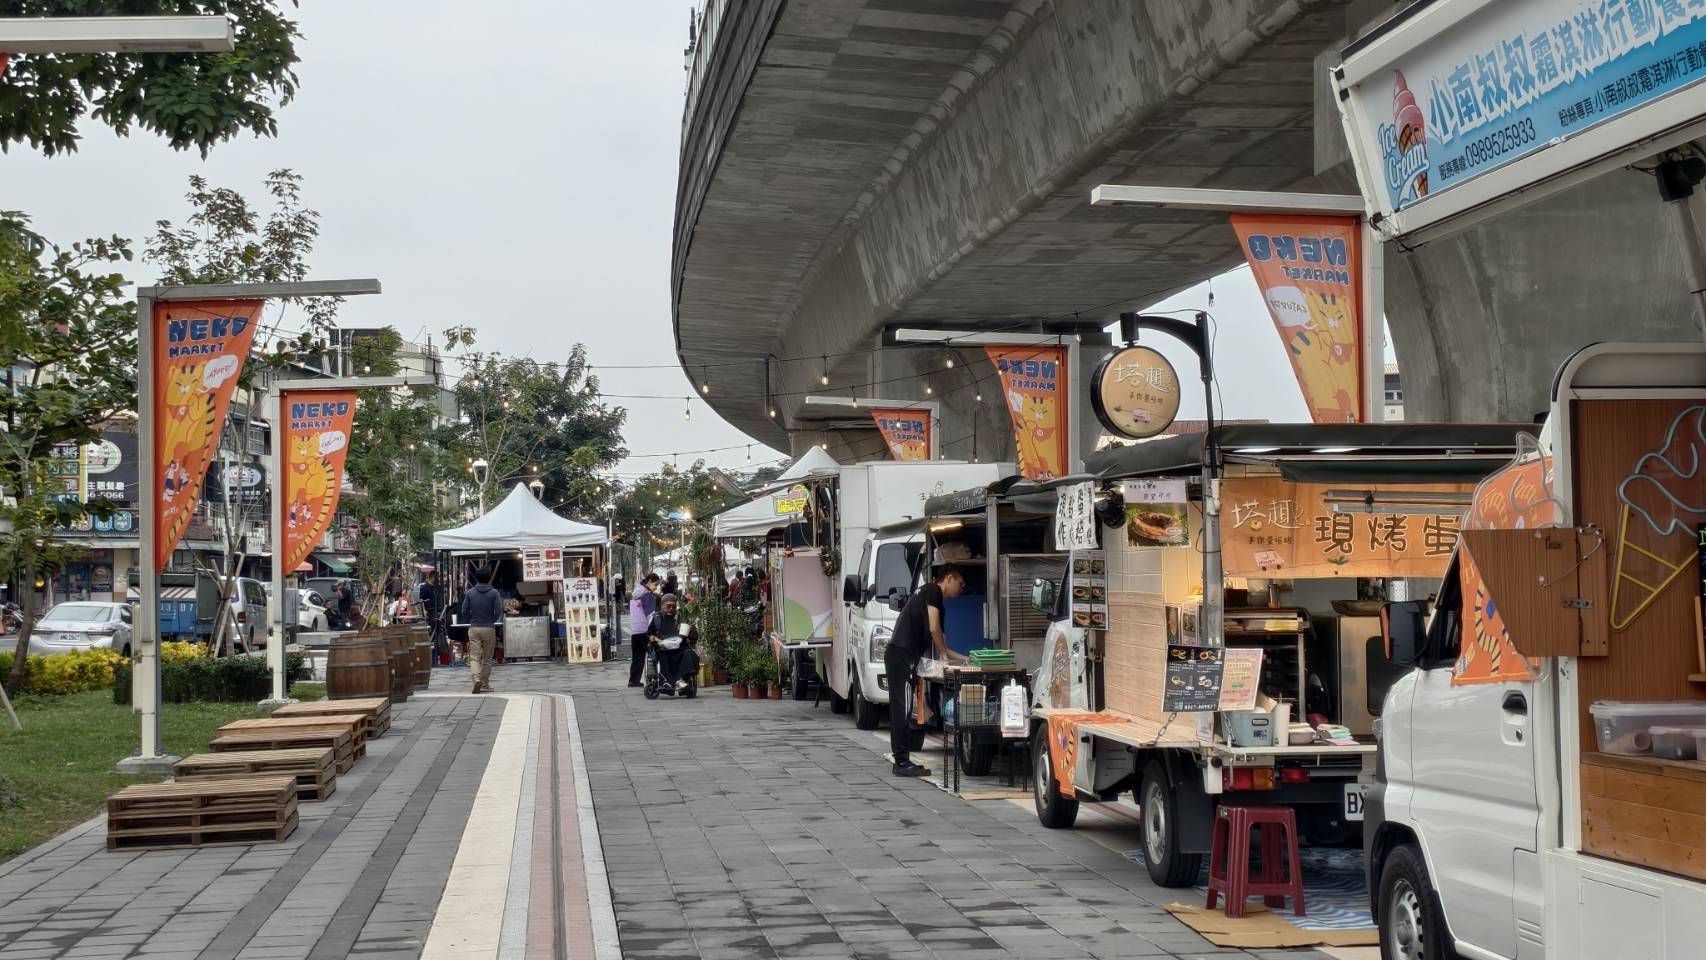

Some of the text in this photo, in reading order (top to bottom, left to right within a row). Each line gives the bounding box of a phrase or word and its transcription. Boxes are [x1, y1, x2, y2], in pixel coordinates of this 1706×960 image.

[1378, 123, 1397, 159] Ice
[1389, 142, 1430, 189] Cream
[168, 342, 225, 359] MARKET
[291, 401, 349, 420] NEKO
